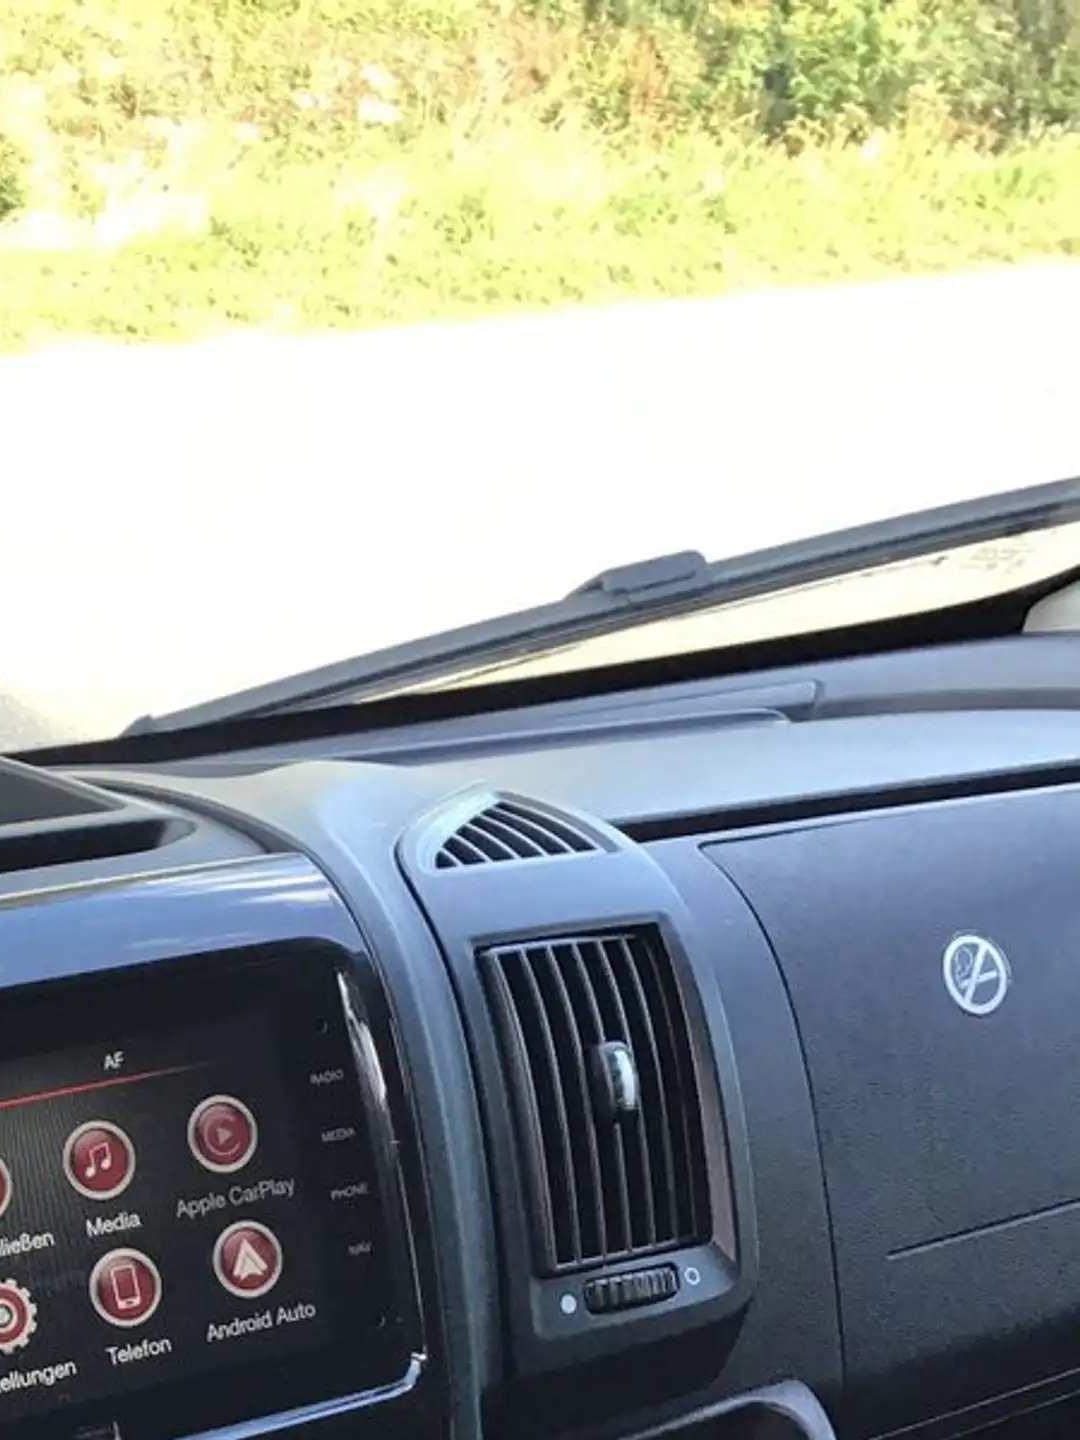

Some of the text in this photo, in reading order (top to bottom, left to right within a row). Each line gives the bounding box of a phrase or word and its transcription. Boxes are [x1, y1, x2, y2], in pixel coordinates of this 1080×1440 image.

[103, 1051, 125, 1070] AF
[176, 1178, 295, 1219] Apple CarPlay
[85, 1211, 142, 1237] Media
[207, 1302, 316, 1342] Android Auto
[106, 1336, 172, 1366] Telefon
